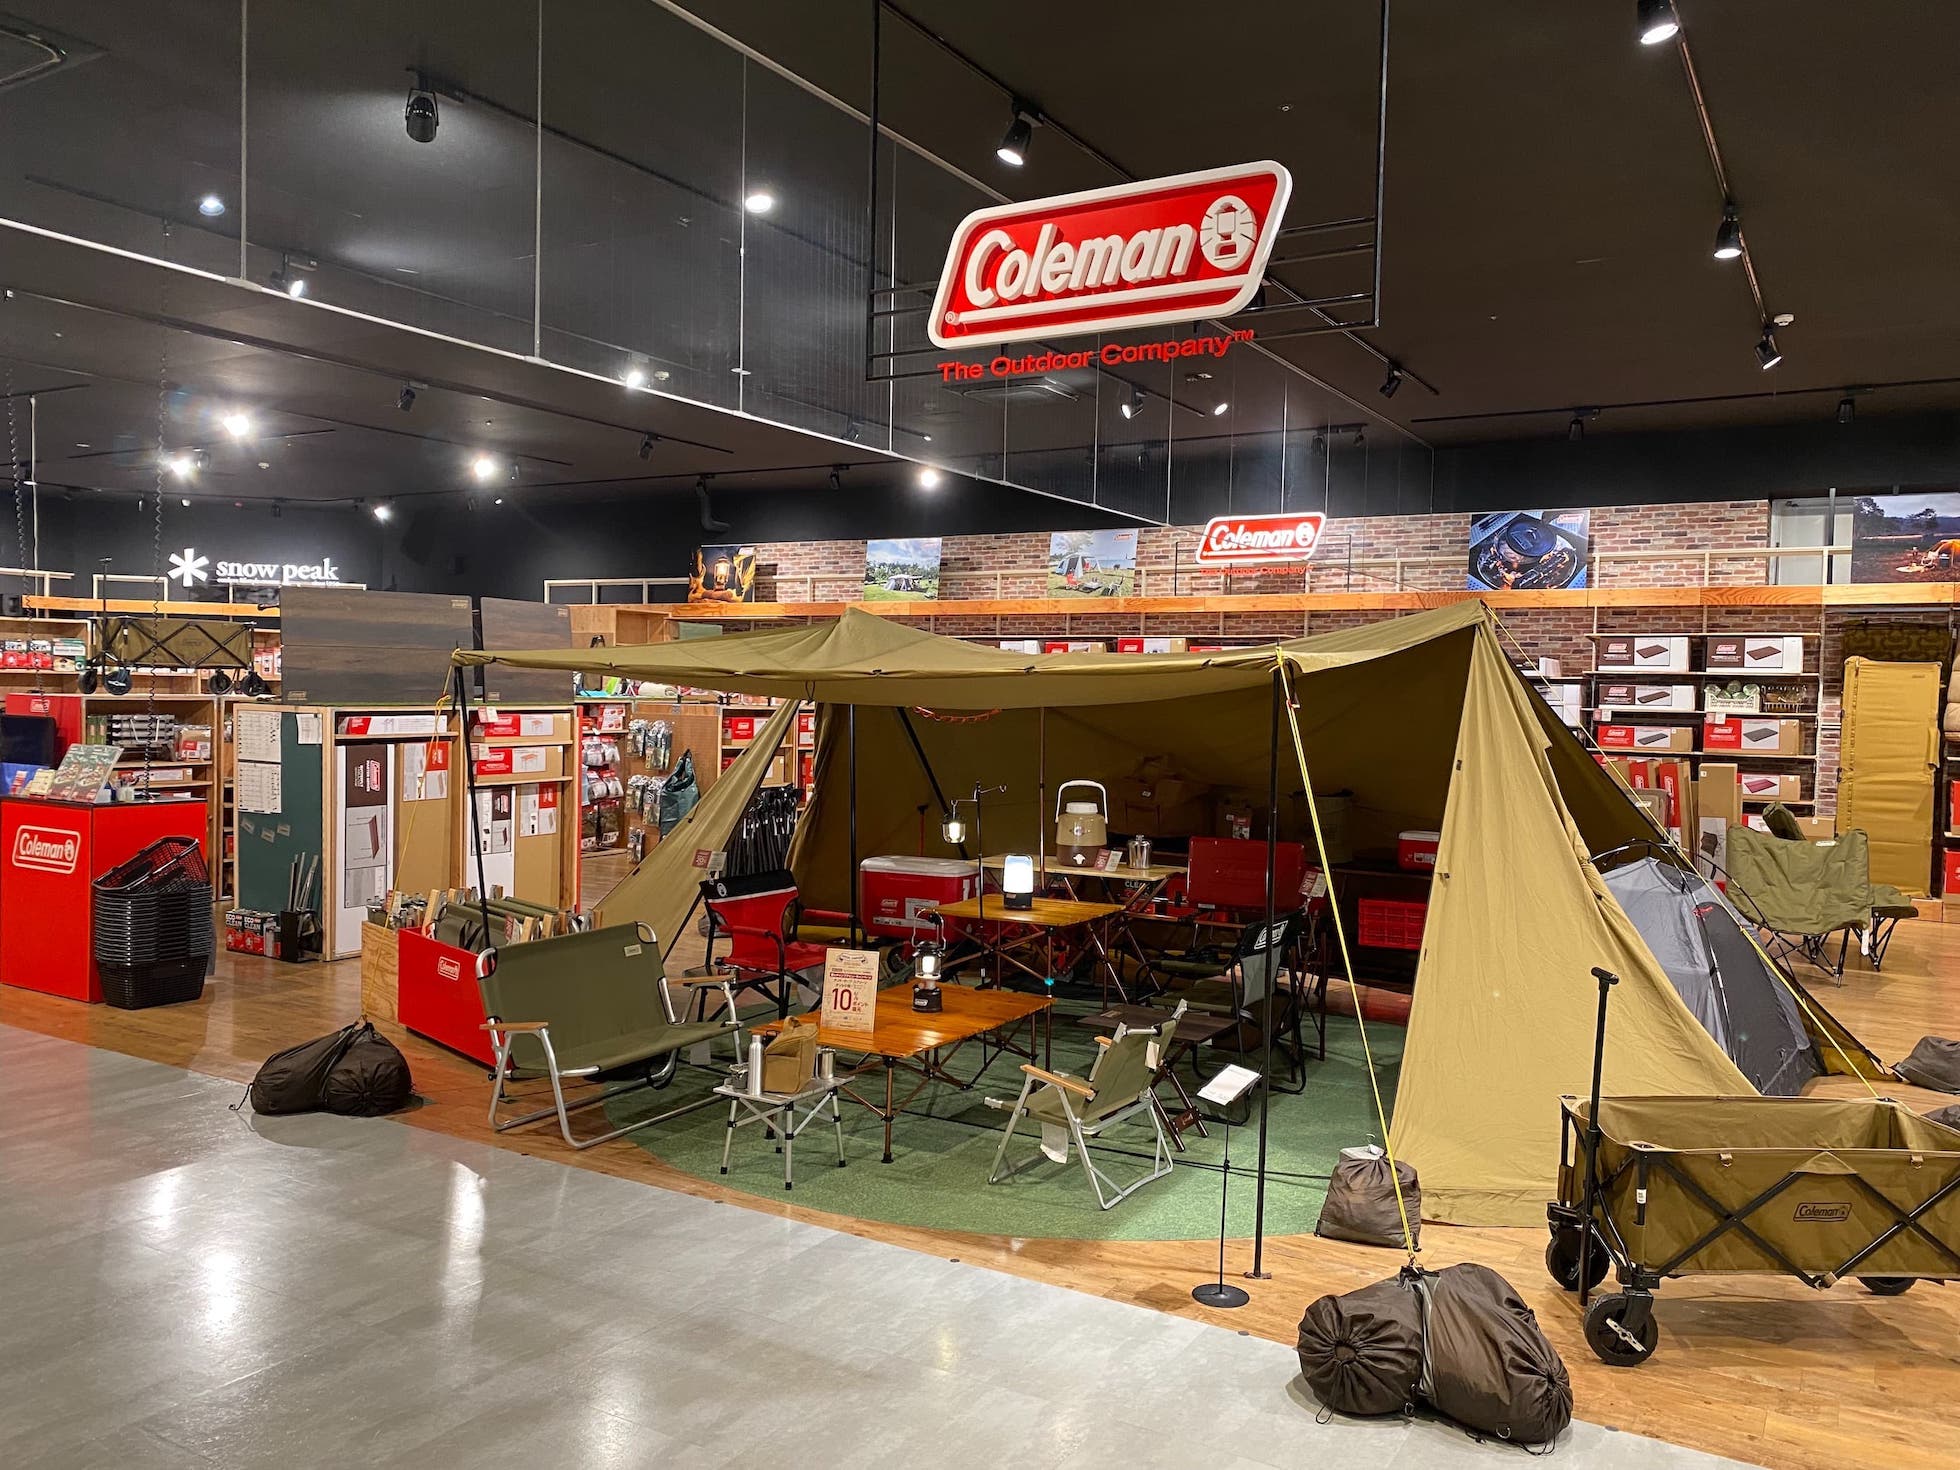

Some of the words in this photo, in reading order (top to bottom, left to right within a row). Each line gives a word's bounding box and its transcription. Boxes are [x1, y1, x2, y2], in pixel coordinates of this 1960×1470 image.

[965, 223, 1198, 308] Coleman
[937, 361, 984, 382] The
[990, 350, 1095, 377] Outdoor
[1210, 525, 1296, 551] Coleman
[216, 561, 279, 578] snow
[282, 557, 339, 586] peak
[20, 832, 64, 860] Coleman
[832, 988, 852, 1011] 10
[1799, 1205, 1839, 1217] Coleman
